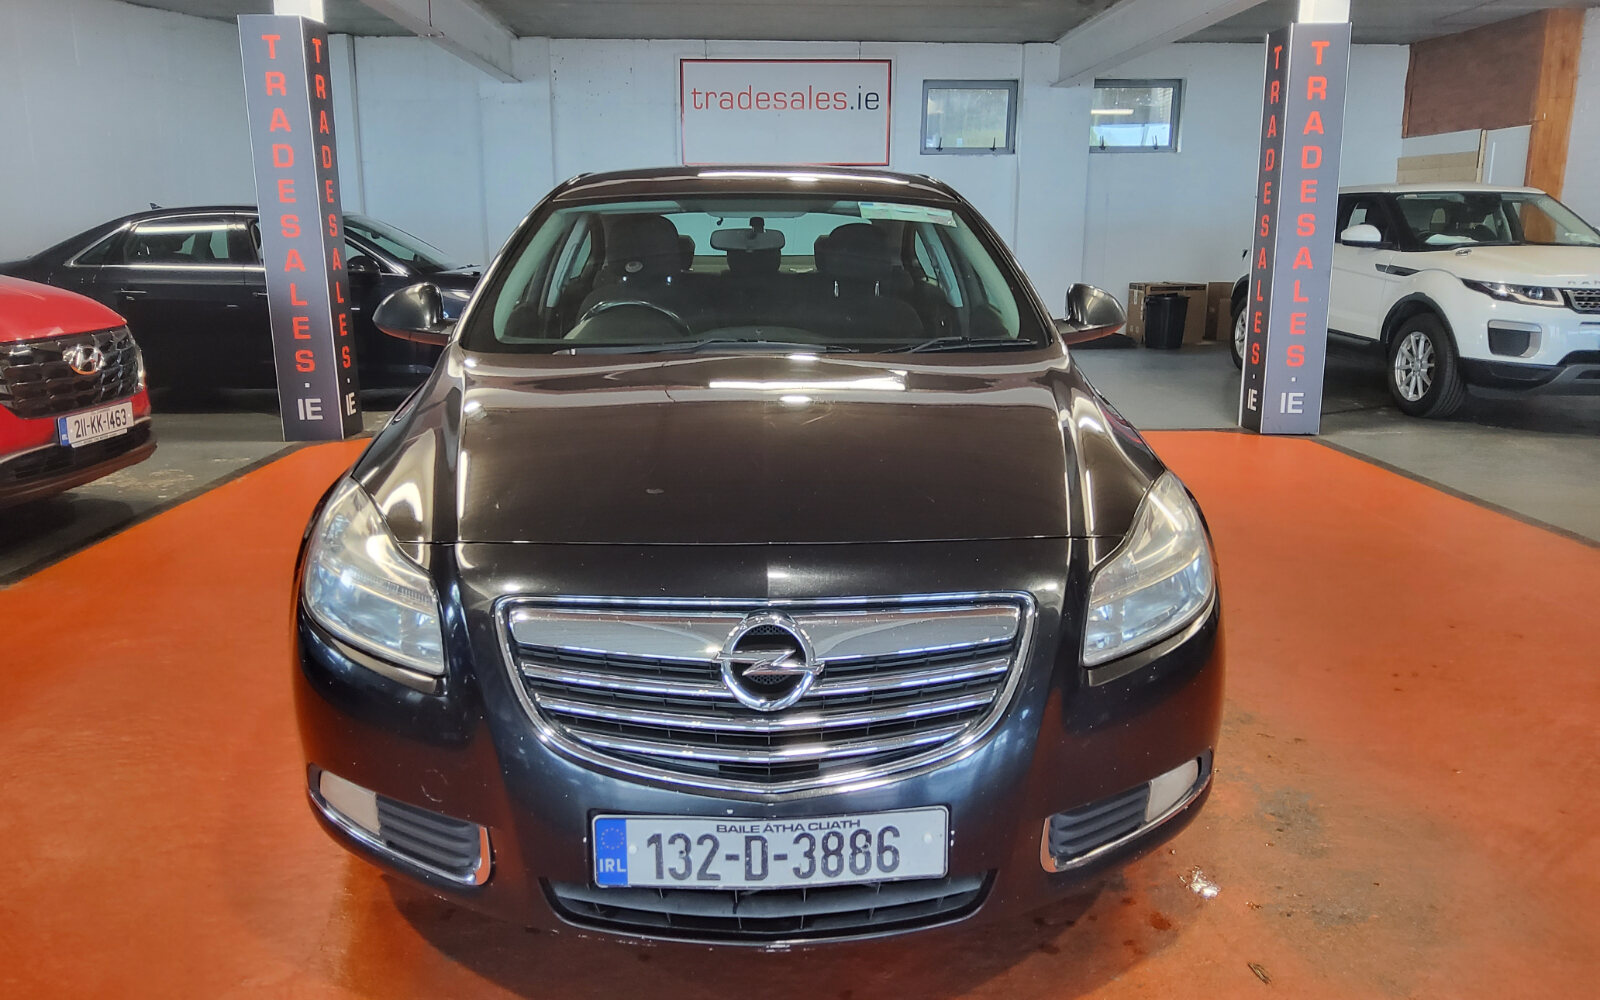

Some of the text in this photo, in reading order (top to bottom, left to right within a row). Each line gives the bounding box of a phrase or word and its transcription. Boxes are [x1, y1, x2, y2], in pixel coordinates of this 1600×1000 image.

[691, 84, 880, 111] tradesales.ie
[74, 408, 127, 438] 211-KK-1463
[716, 819, 861, 833] BAILE ÁTHA CLIATH
[599, 858, 627, 873] IRL
[646, 825, 901, 881] 132-D-3886
